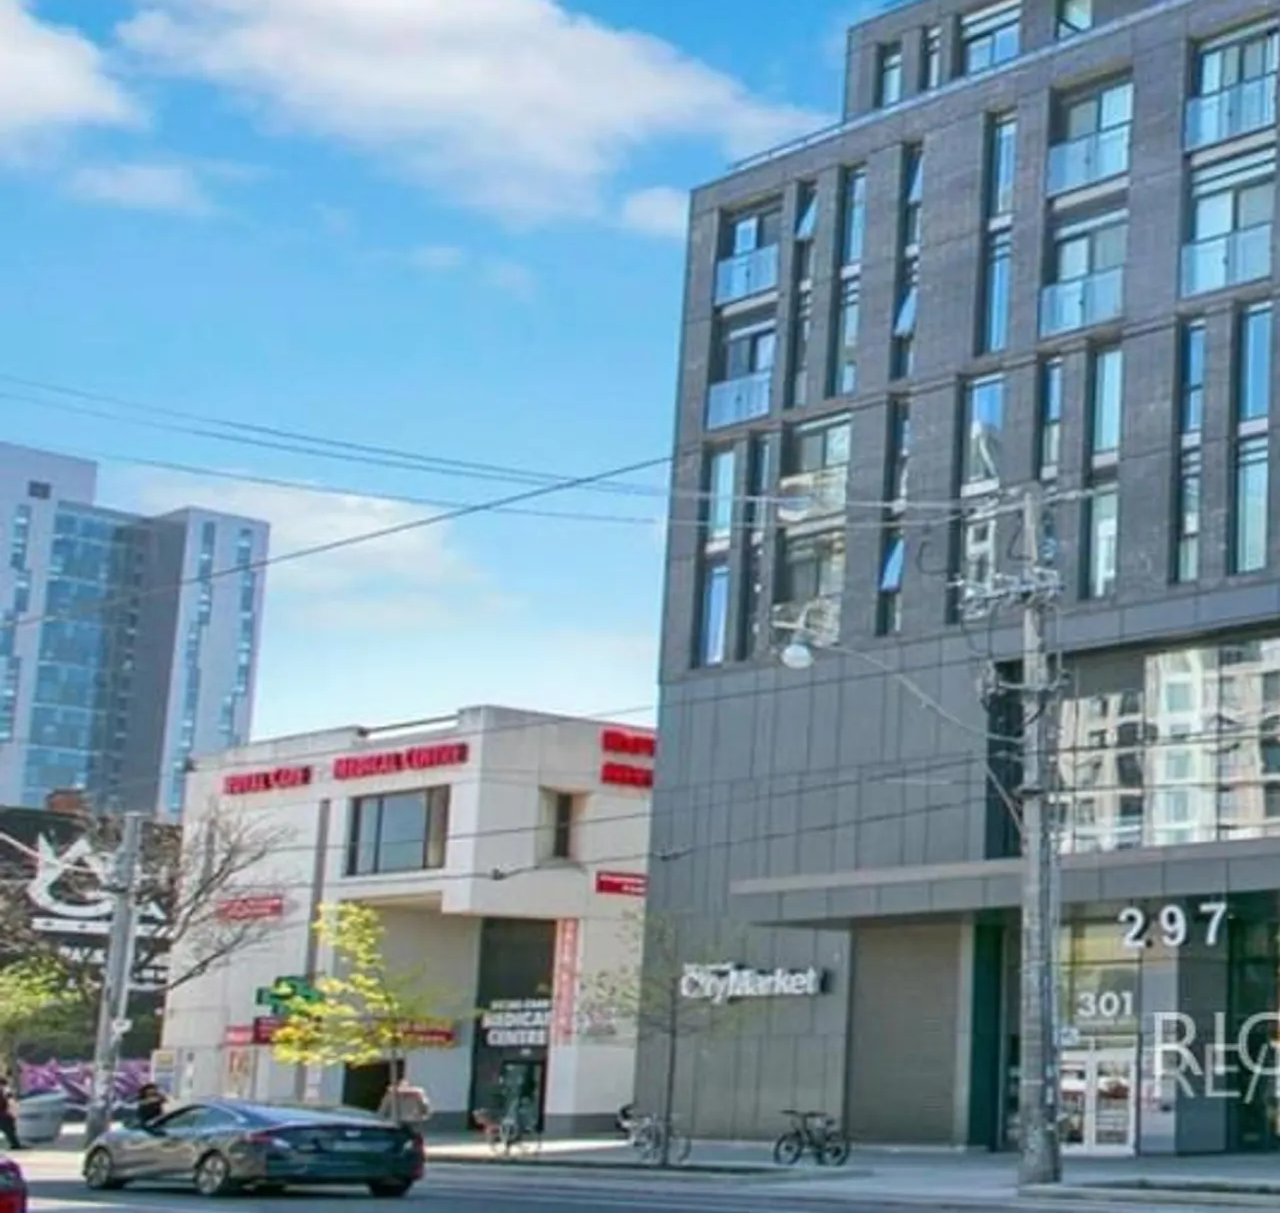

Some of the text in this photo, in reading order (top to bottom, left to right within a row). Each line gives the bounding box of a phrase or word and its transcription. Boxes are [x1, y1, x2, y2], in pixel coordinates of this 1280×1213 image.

[1118, 901, 1228, 949] 297
[680, 968, 816, 1004] CityMarket
[1077, 991, 1134, 1018] 301
